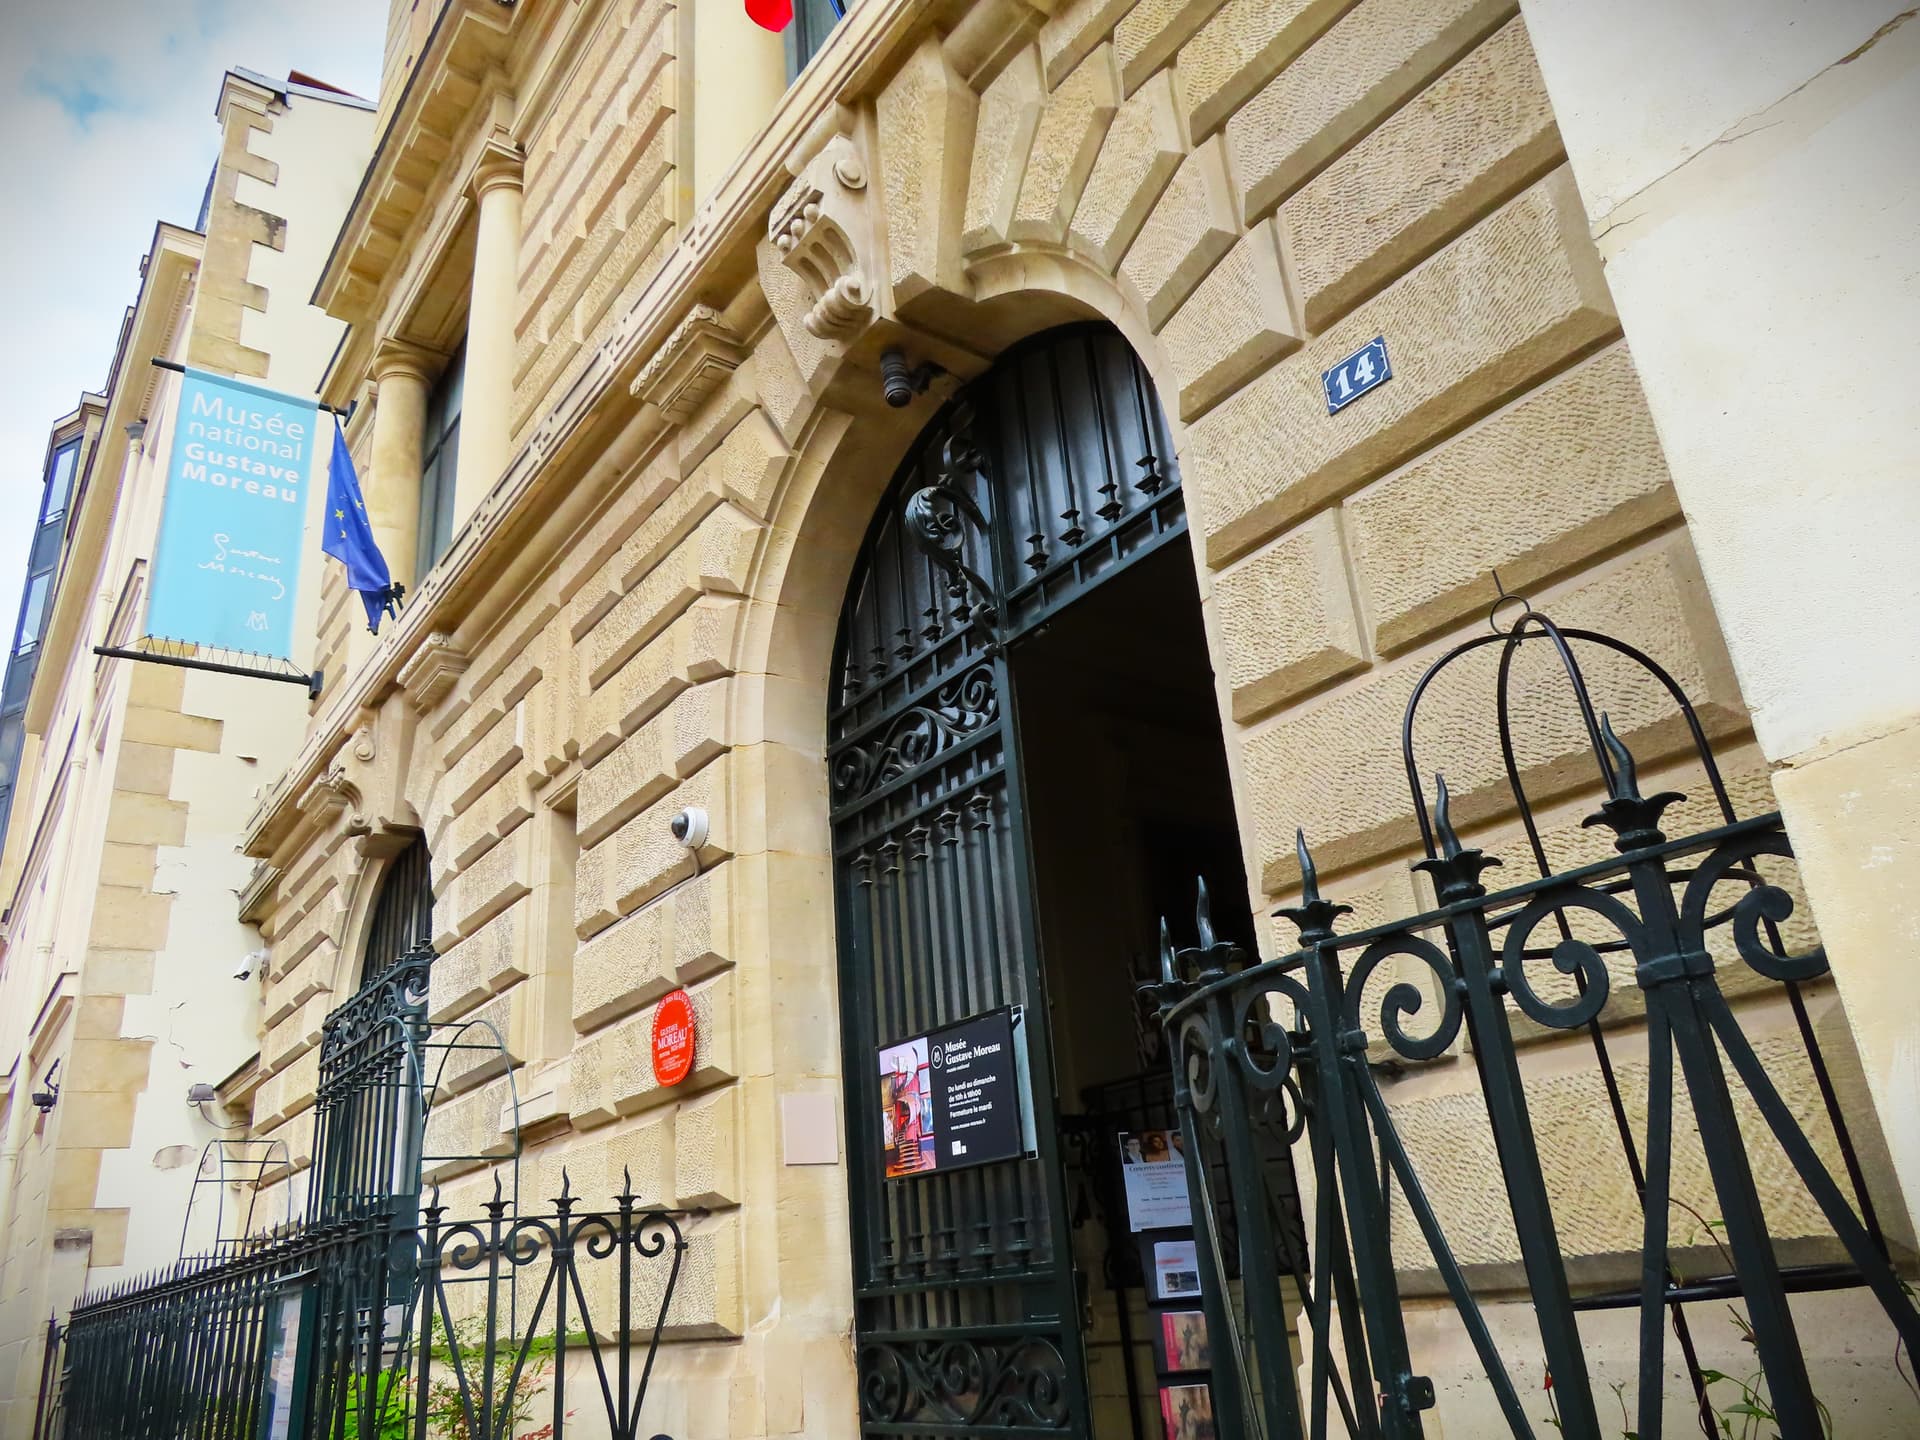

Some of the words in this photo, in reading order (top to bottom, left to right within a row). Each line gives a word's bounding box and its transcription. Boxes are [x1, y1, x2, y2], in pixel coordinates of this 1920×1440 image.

[1335, 351, 1376, 399] 14
[192, 391, 305, 441] Musée
[189, 421, 303, 461] national
[185, 442, 299, 483] Gustave
[182, 461, 298, 503] Moreau
[657, 1027, 688, 1051] MOREAU
[945, 1038, 967, 1054] Musée
[945, 1051, 973, 1065] Gustave
[973, 1043, 1001, 1058] Moreau
[954, 1081, 967, 1091] lundi
[973, 1074, 996, 1087] dimanche
[978, 1101, 993, 1112] mardi
